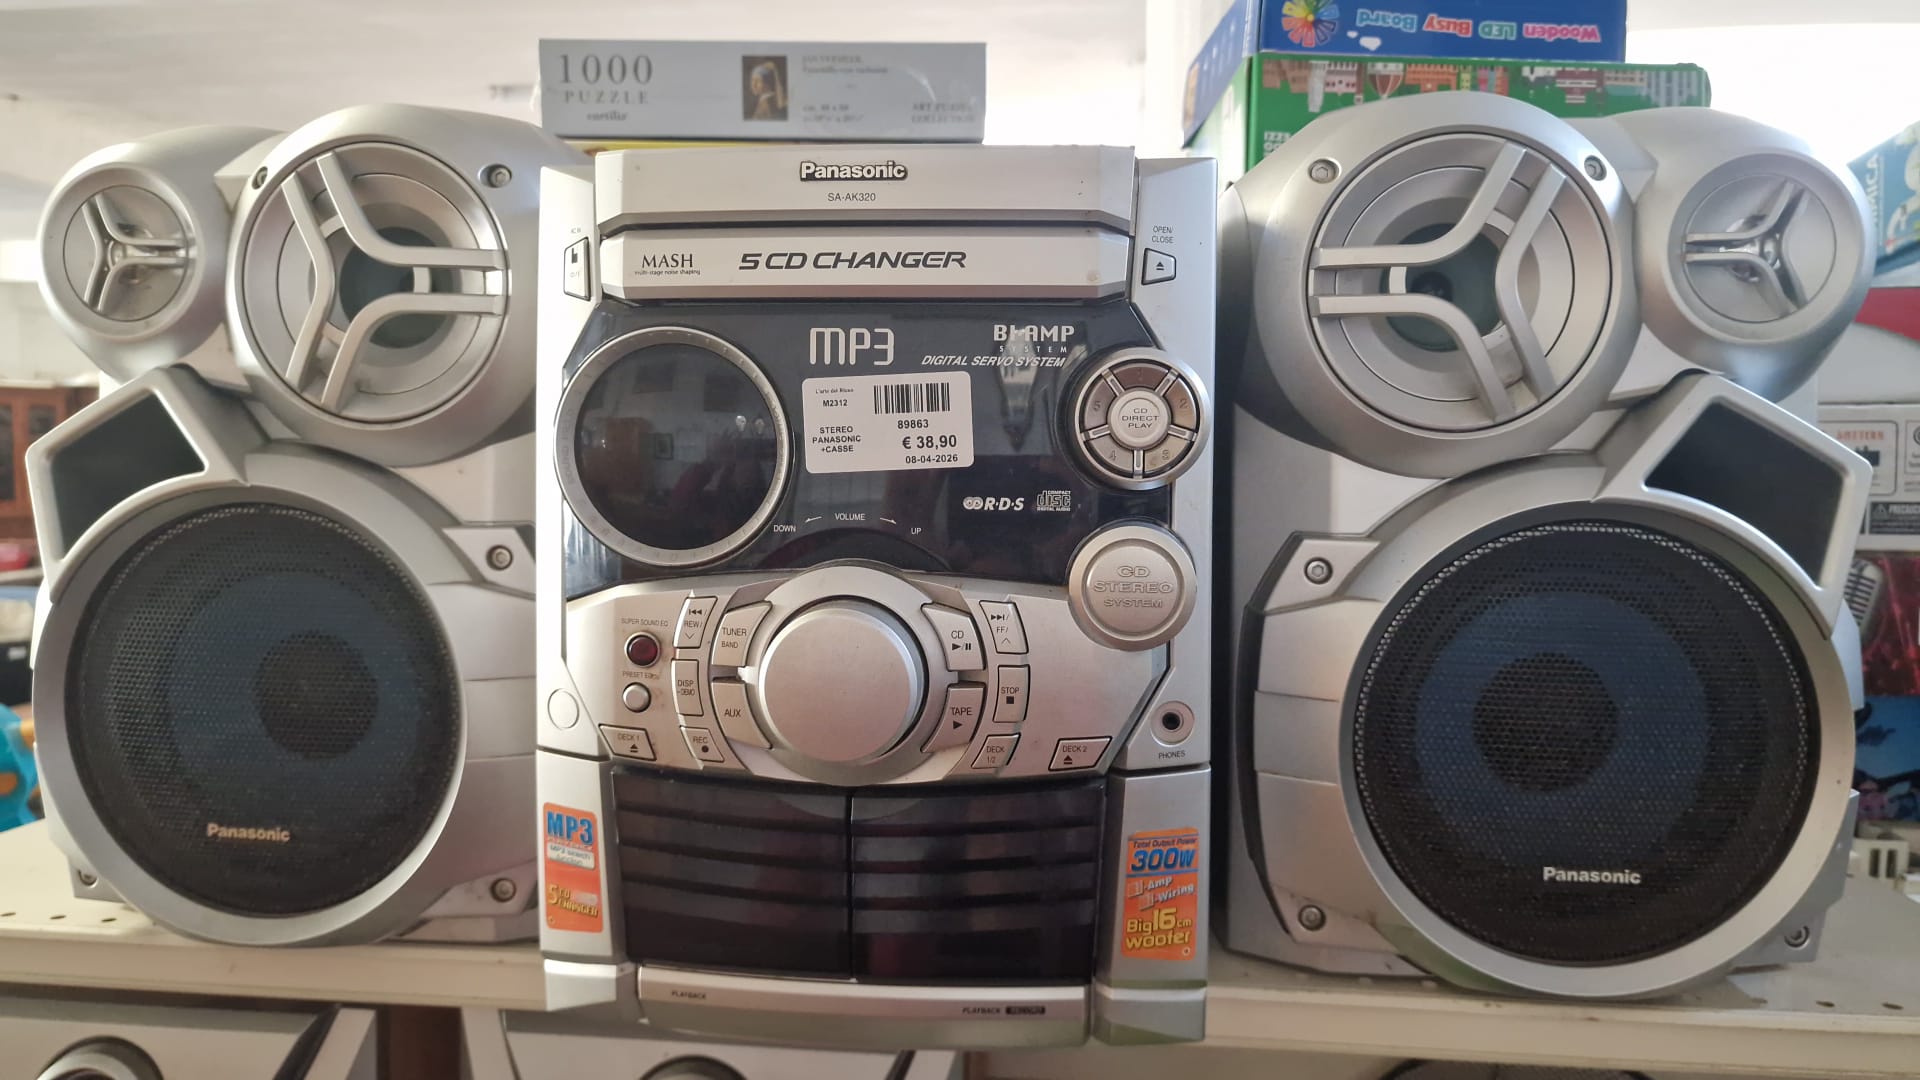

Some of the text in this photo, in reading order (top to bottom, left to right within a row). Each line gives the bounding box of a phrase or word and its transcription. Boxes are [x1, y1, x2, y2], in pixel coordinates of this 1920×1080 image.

[1356, 8, 1601, 42] Wooden LED Busy Board
[560, 54, 653, 84] 1000
[564, 90, 650, 104] PUZZLE
[800, 161, 907, 181] Panasonic
[827, 193, 876, 202] SA-AK320
[1151, 235, 1174, 243] CLOSE
[641, 253, 694, 268] MASH
[739, 251, 967, 270] 5 CD CHANGER
[810, 327, 895, 366] MP3
[921, 355, 1066, 368] DIGITAL SERVO SYSTEM
[822, 399, 848, 407] M2312
[897, 419, 929, 429] 89863
[819, 426, 854, 434] STEREO
[812, 435, 861, 444] PANASONIC
[902, 435, 957, 450] € 38,90
[821, 445, 854, 453] +CASSE
[905, 455, 958, 464] 08-04-2026
[834, 513, 866, 521] VOLUME
[773, 525, 796, 533] DOWN
[1117, 565, 1151, 578] CD
[1093, 581, 1174, 593] STEREO
[1103, 599, 1163, 608] SYSTEM
[721, 627, 747, 637] TUNER
[950, 630, 964, 640] CD
[721, 641, 739, 649] BAND
[677, 679, 694, 687] DISP
[1000, 686, 1020, 695] STOP
[723, 707, 742, 718] AUX
[950, 707, 973, 716] TAPE
[617, 733, 636, 742] DECK
[692, 736, 709, 744] REC
[986, 745, 1005, 753] DECK
[1062, 745, 1088, 753] DECK 2
[1158, 750, 1186, 759] PHONES
[207, 823, 291, 842] Panasonic
[547, 811, 593, 845] MP3
[1133, 837, 1198, 849] Total Output Power
[1543, 866, 1641, 885] Panasonic
[548, 885, 561, 904] 5
[1127, 908, 1192, 936] Big 16 cm
